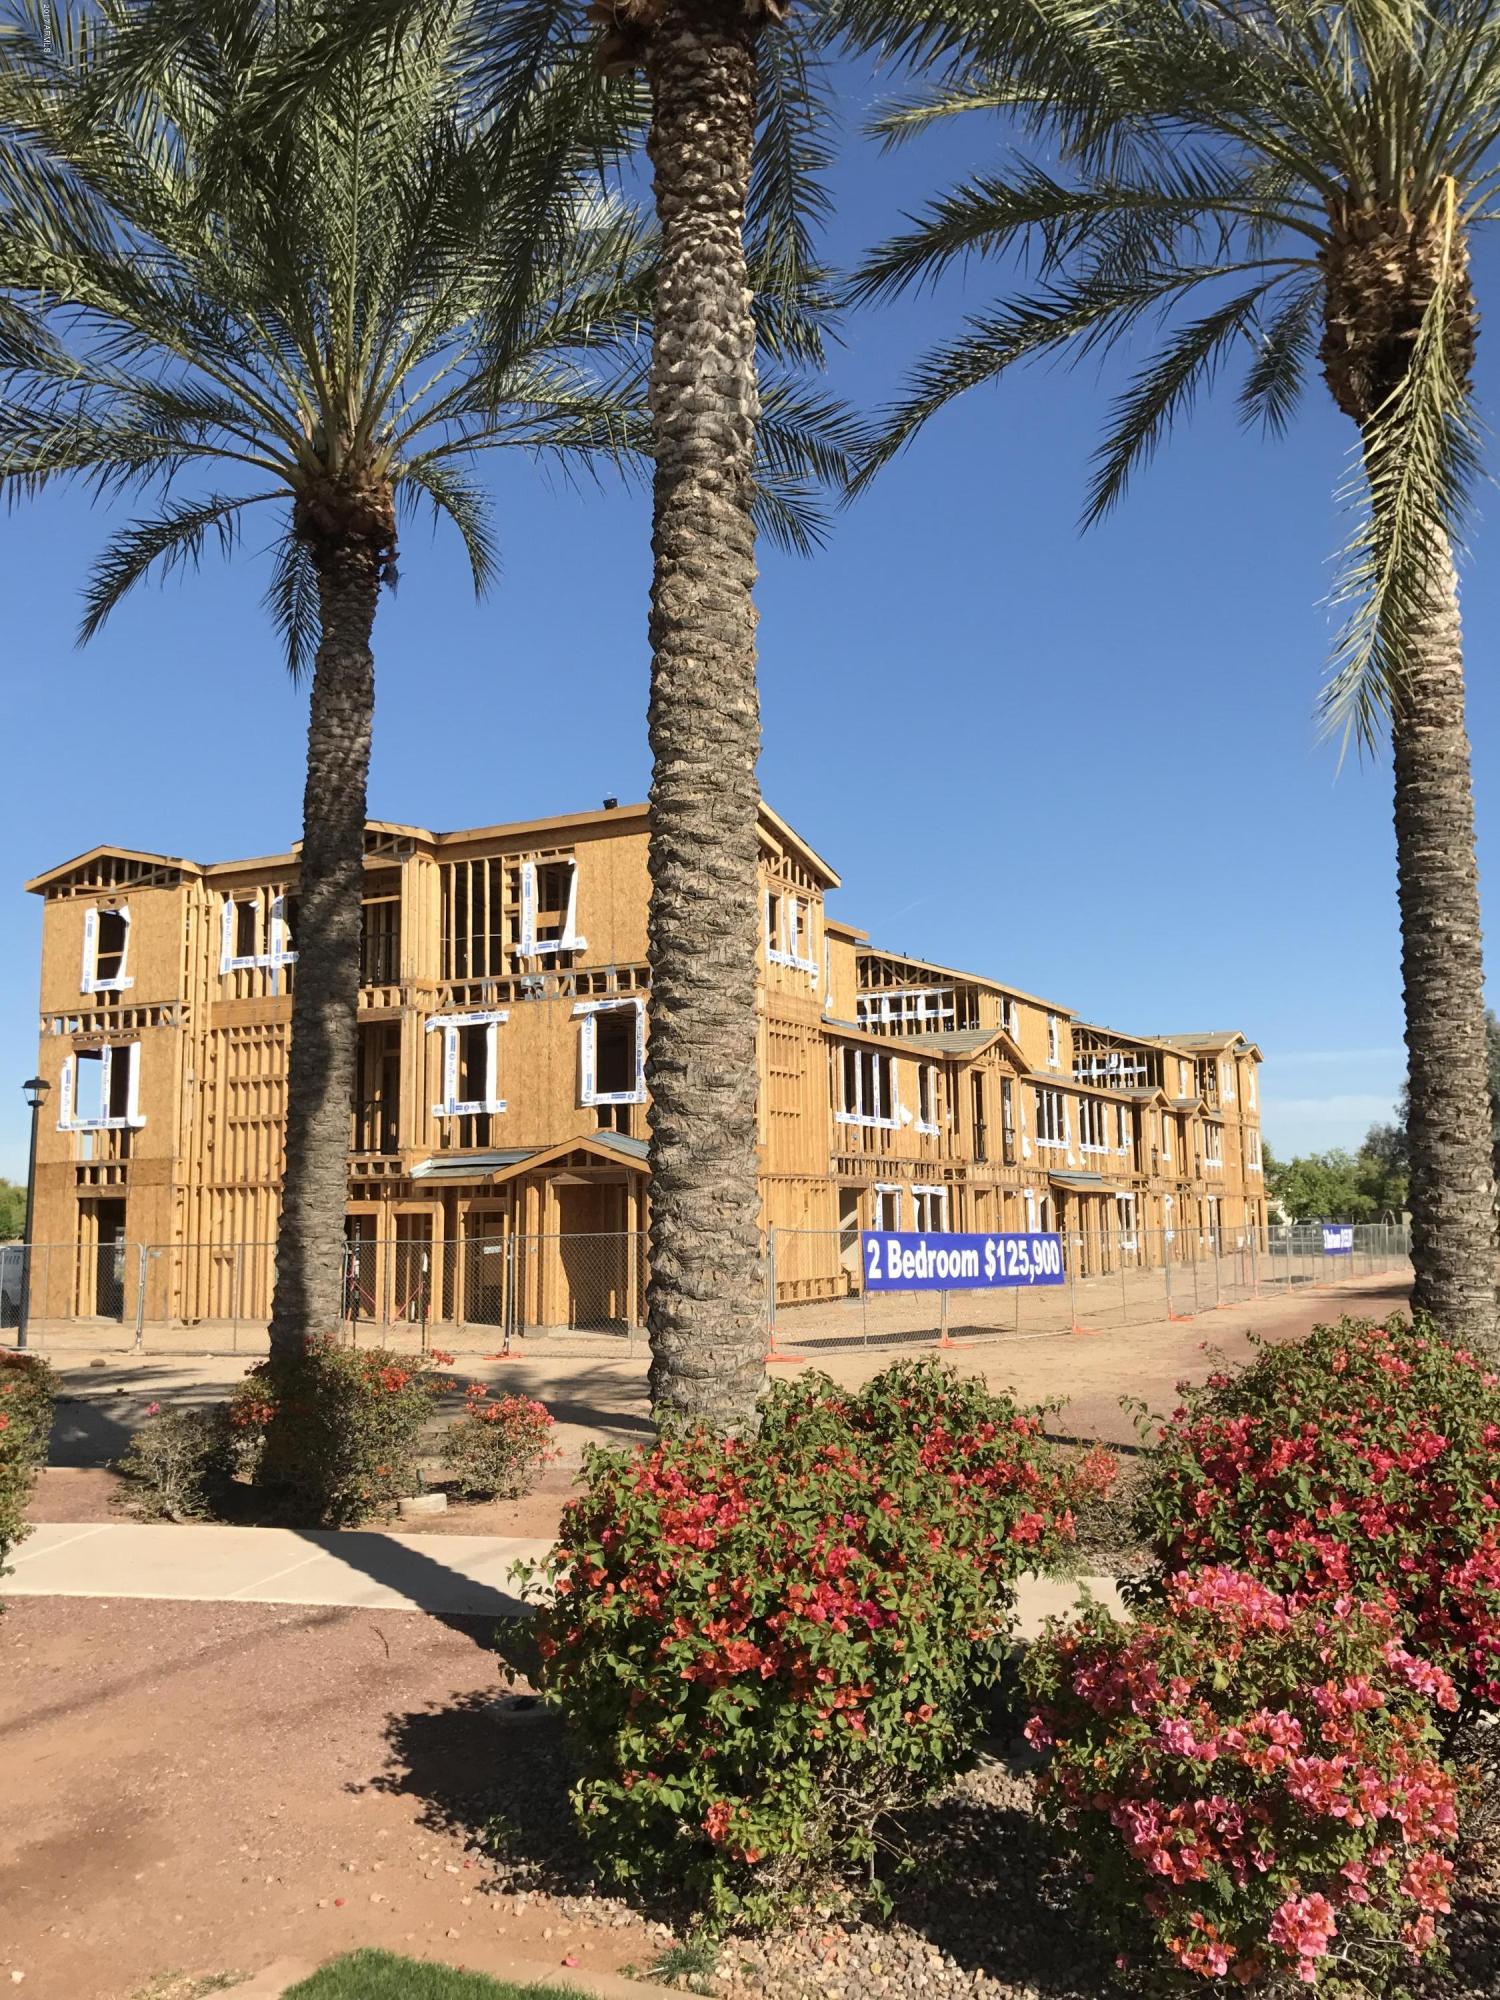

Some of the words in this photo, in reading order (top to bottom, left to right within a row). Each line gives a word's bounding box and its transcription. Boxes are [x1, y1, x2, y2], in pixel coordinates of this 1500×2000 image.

[867, 1238, 882, 1279] 2
[887, 1239, 979, 1279] Bedroom
[984, 1237, 1061, 1284] $125,900
